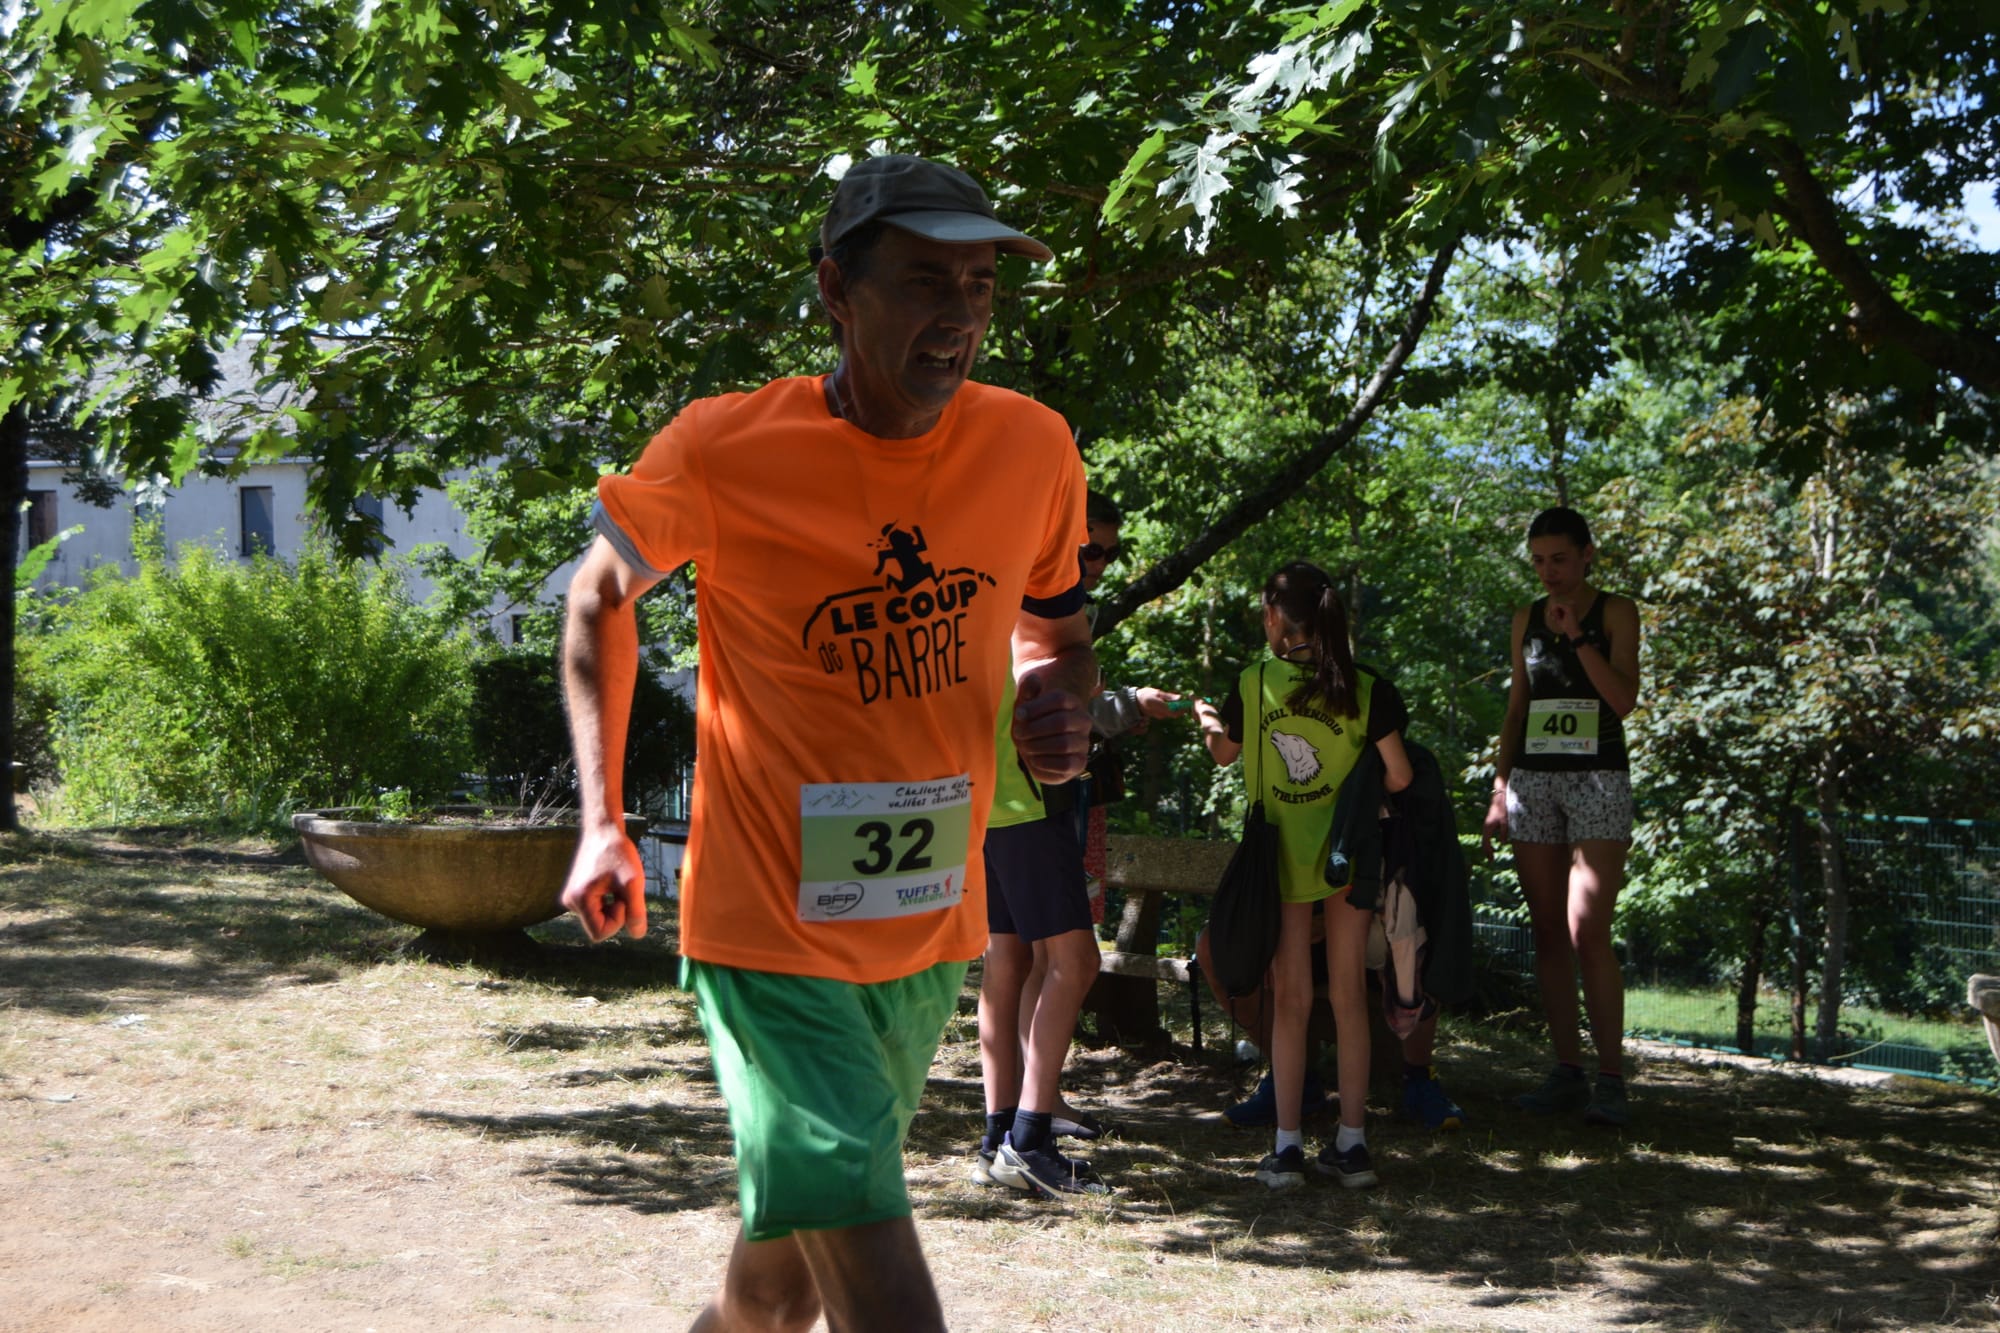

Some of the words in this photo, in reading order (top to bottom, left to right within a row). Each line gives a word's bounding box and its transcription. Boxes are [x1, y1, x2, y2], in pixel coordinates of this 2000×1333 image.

[830, 602, 878, 635] LE
[885, 579, 977, 624] COUP
[818, 641, 843, 674] de
[851, 613, 967, 704] BARRE
[1543, 713, 1577, 736] 40
[895, 784, 946, 798] Challenge
[852, 818, 934, 875] 32
[817, 894, 857, 906] BFP
[896, 882, 940, 900] TUFF'S
